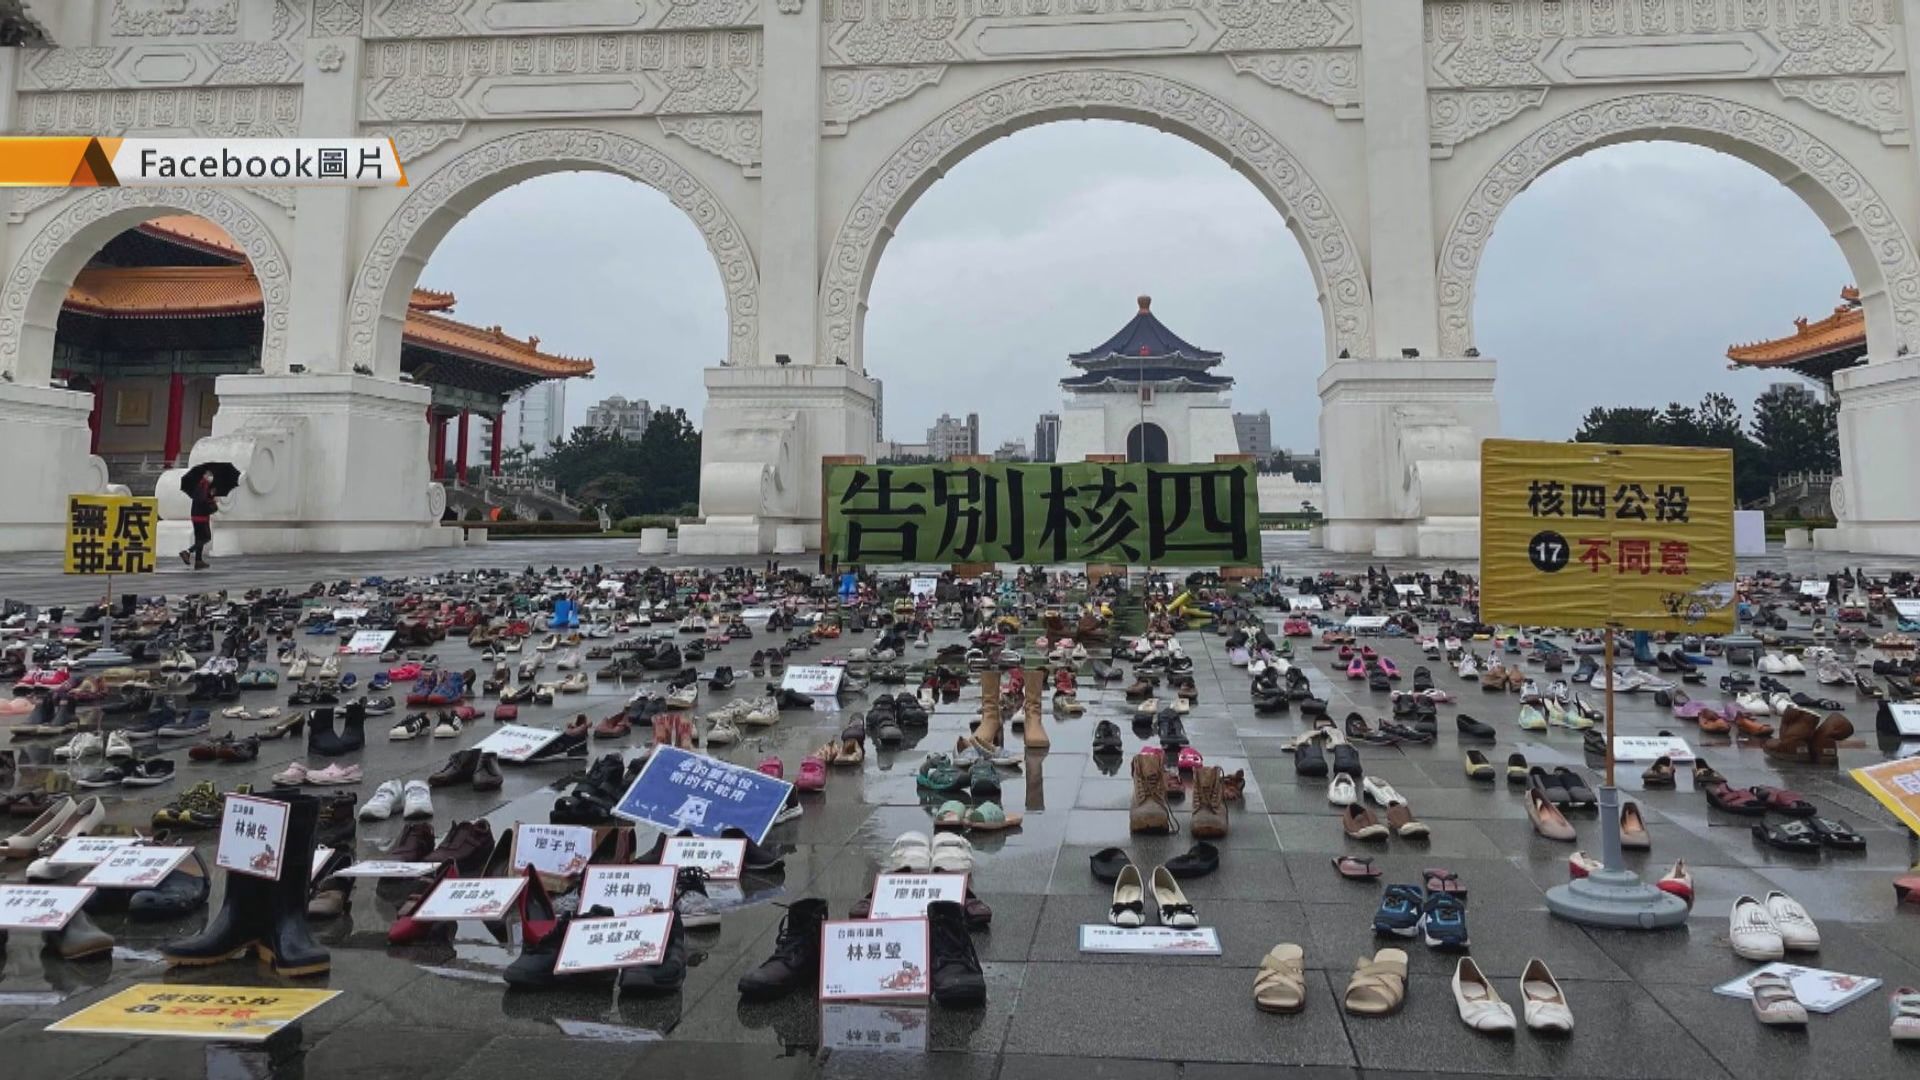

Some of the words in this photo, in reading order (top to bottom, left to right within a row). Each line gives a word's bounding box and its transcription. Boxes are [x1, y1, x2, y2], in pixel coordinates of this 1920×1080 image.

[840, 465, 1248, 562] 告別核四
[1528, 480, 1690, 523] 核四公投
[71, 499, 153, 541] 無底
[1535, 542, 1562, 563] 17
[1578, 538, 1690, 576] 不同意
[235, 819, 267, 841] 林昶佐
[604, 883, 651, 897] 洪申翰
[838, 928, 884, 938] 台南市議員
[847, 942, 902, 961] 林易瑩
